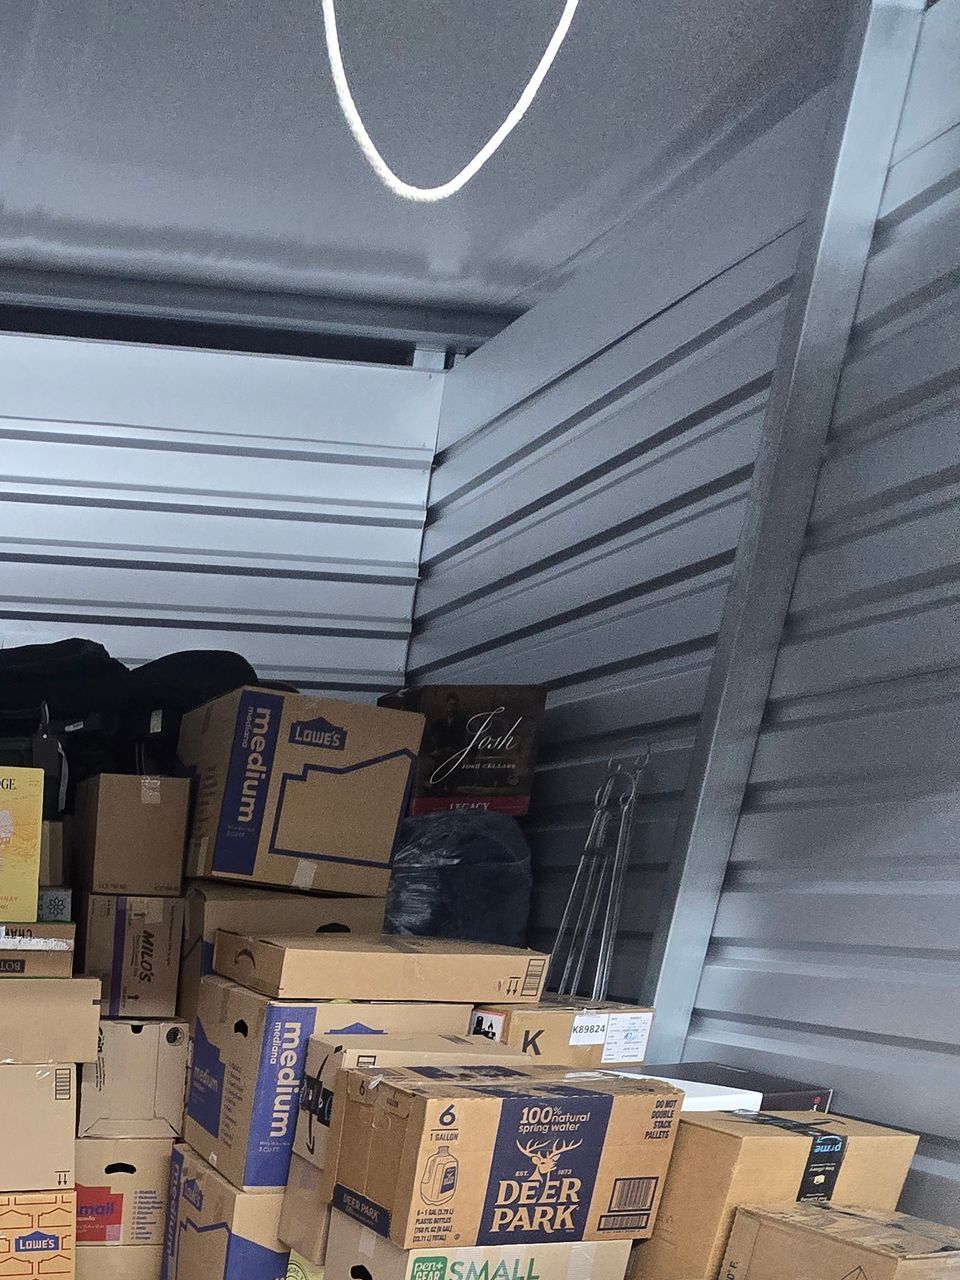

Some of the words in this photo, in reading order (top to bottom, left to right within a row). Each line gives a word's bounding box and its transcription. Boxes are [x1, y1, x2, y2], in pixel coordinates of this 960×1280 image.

[242, 706, 254, 748] mediana
[295, 726, 342, 747] LOWE'S
[429, 706, 523, 784] Josh
[238, 707, 272, 823] medium
[572, 1024, 606, 1034] K89824
[270, 1022, 281, 1064] mediana
[522, 1029, 544, 1056] K
[270, 1022, 302, 1137] medium
[652, 1110, 675, 1119] DOUBLE
[656, 1100, 665, 1108] DO
[666, 1100, 678, 1108] NOT
[439, 1104, 456, 1126] 6
[520, 1106, 562, 1124] 100%
[552, 1112, 590, 1122] natural
[653, 1120, 672, 1129] STACK
[518, 1124, 548, 1134] spring
[551, 1123, 580, 1132] water
[644, 1131, 670, 1139] PALLETS
[495, 1178, 582, 1206] DEER
[342, 1191, 361, 1211] DEER
[360, 1201, 381, 1224] PARK
[490, 1205, 579, 1233] PARK
[20, 1238, 55, 1249] LOWE'S
[414, 1261, 444, 1275] pen+
